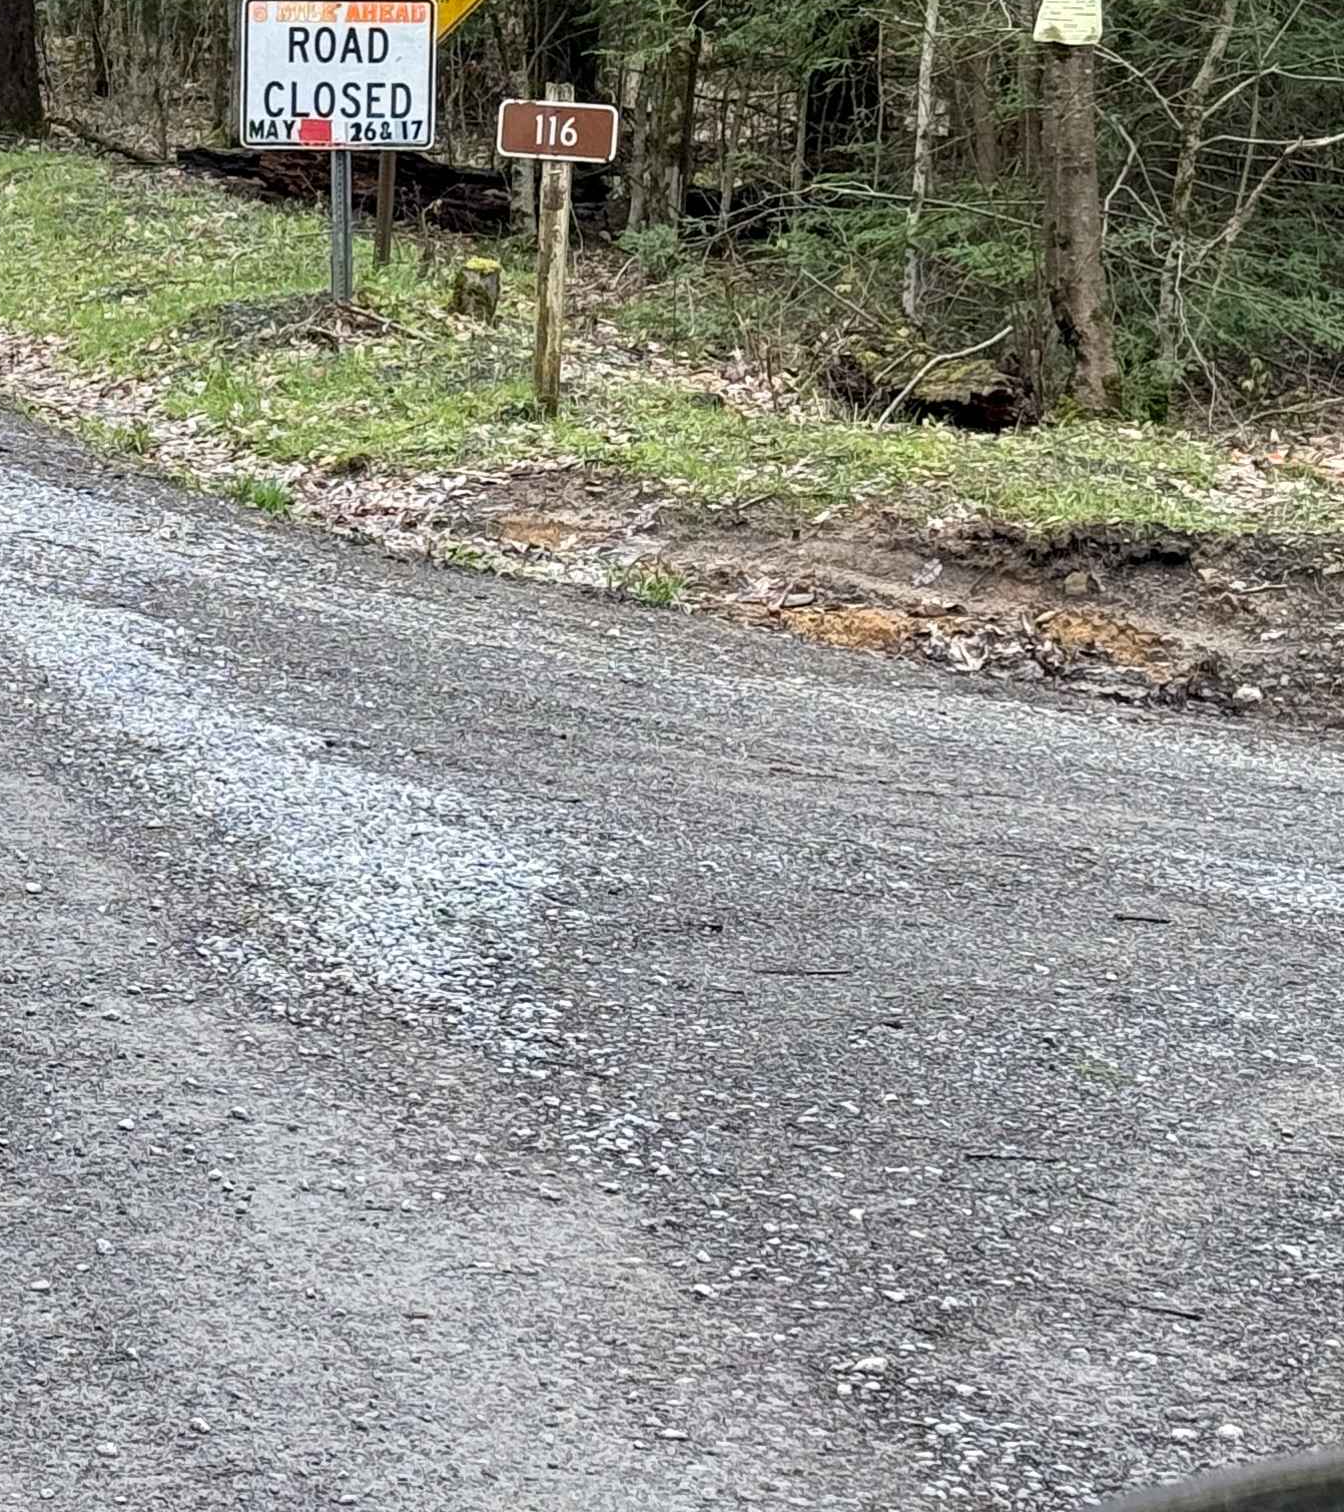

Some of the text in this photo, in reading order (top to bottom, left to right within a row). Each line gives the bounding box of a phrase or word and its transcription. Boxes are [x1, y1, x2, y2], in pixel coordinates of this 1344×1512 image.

[345, 3, 426, 23] AHEAD
[288, 27, 389, 63] ROAD
[264, 81, 412, 118] CLOSED
[249, 120, 295, 141] MAY
[401, 120, 424, 140] 17
[535, 114, 578, 147] 116
